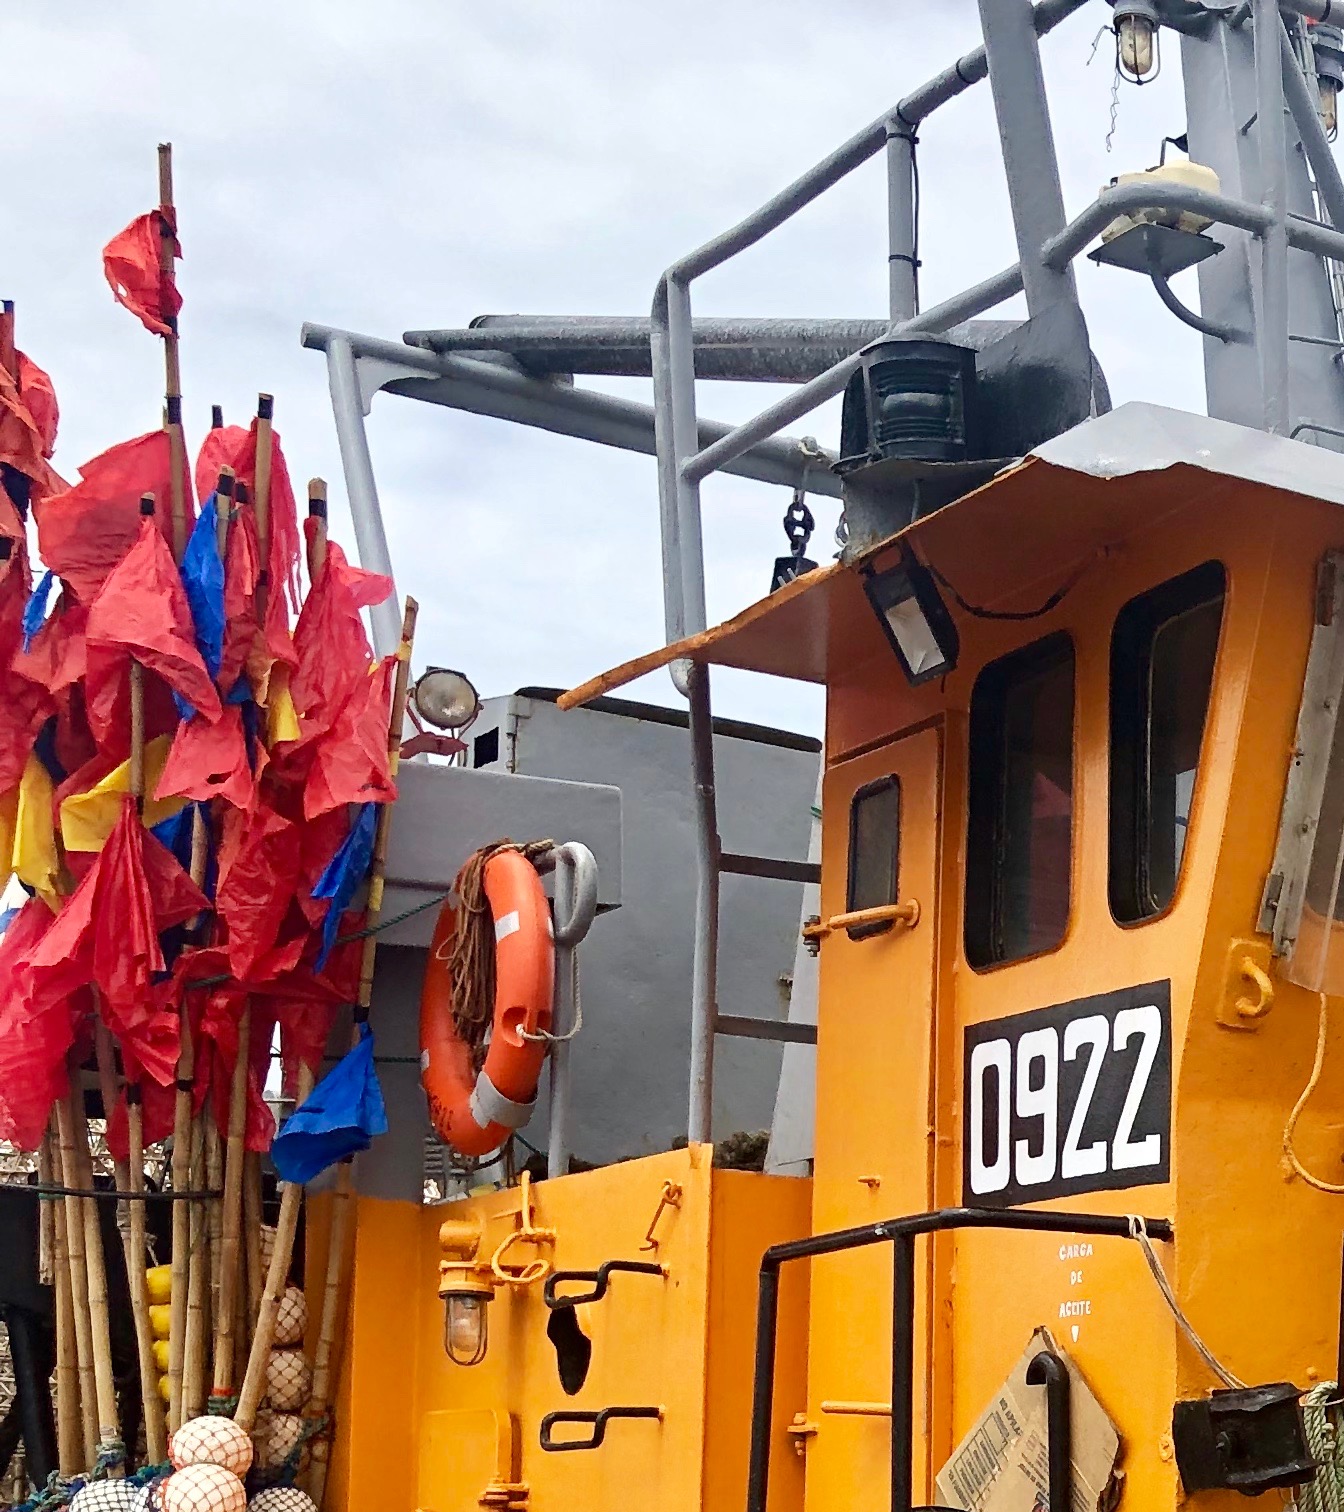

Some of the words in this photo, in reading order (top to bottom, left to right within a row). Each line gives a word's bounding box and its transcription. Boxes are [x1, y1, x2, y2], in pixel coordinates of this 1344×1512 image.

[970, 1005, 1162, 1195] 0922
[1059, 1243, 1093, 1260] CARGA
[1070, 1270, 1083, 1285] DE
[1059, 1301, 1091, 1318] ACEITE
